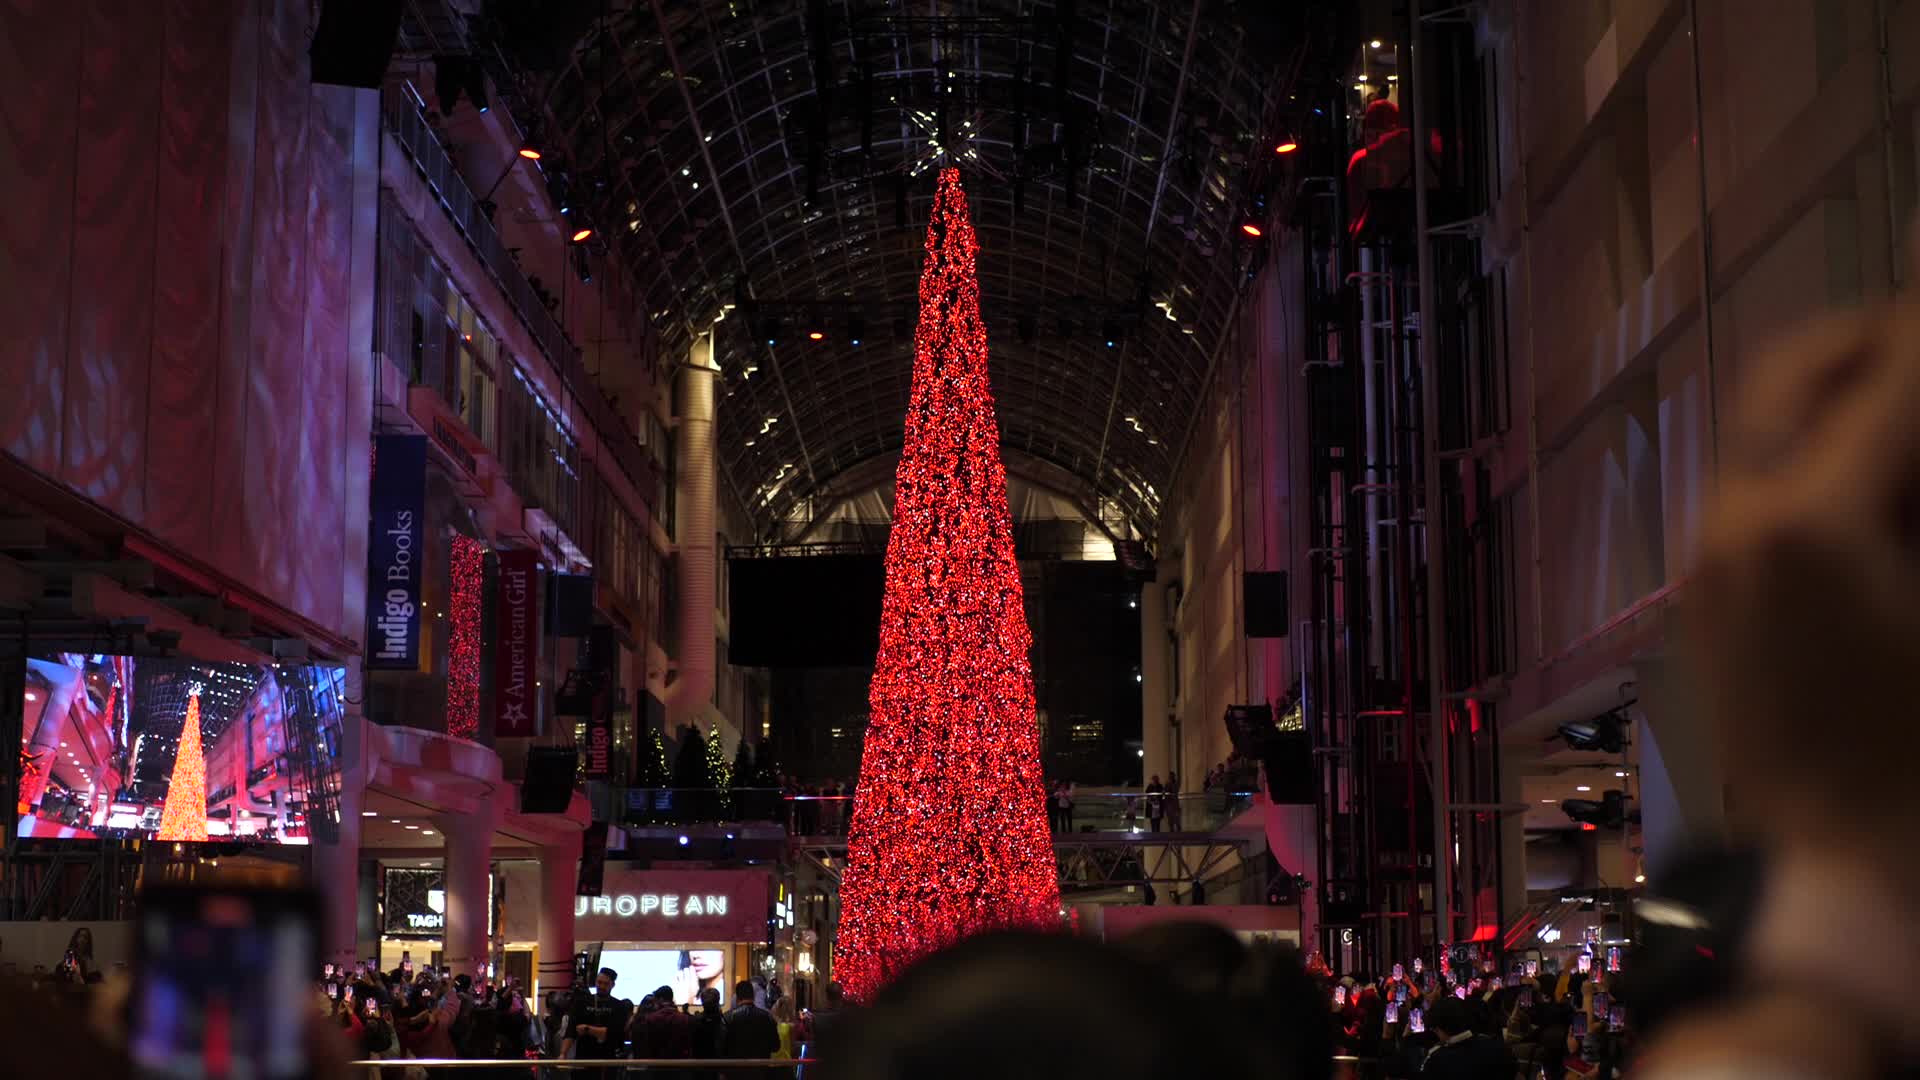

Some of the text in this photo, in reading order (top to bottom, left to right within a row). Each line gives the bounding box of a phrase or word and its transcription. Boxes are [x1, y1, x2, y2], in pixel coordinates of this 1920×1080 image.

[387, 510, 412, 581] Books
[504, 567, 526, 698] American Girl
